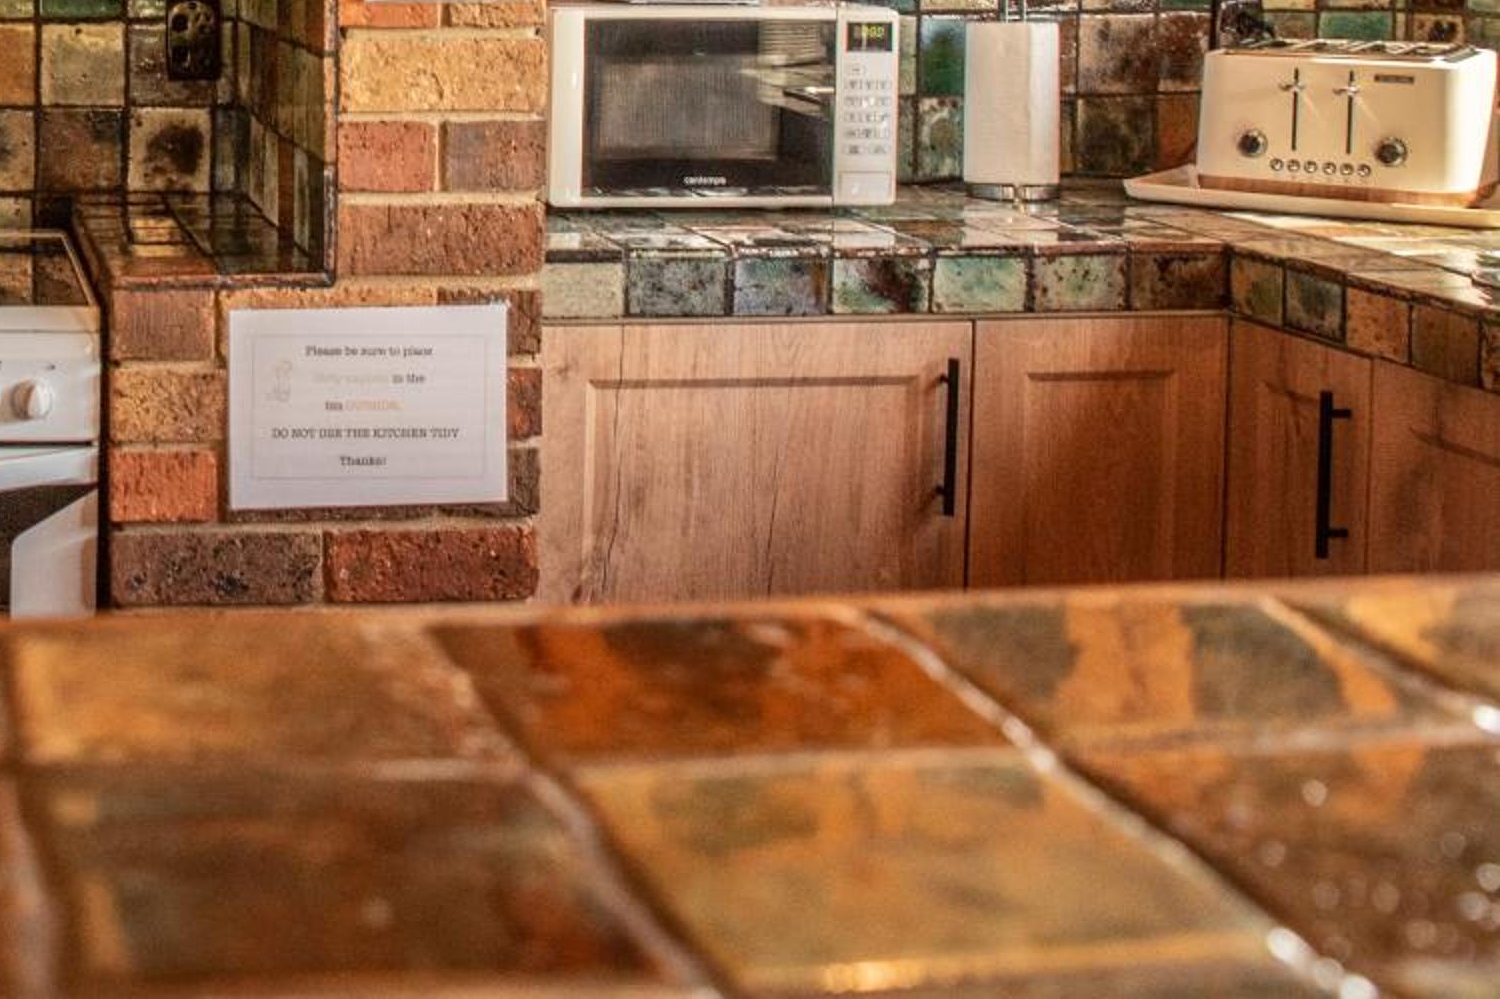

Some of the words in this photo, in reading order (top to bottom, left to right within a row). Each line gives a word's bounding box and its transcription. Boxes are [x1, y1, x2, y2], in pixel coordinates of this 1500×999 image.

[271, 428, 289, 439] DO
[291, 427, 317, 439] NOT
[345, 427, 370, 439] THE
[372, 427, 428, 439] KITCHEN
